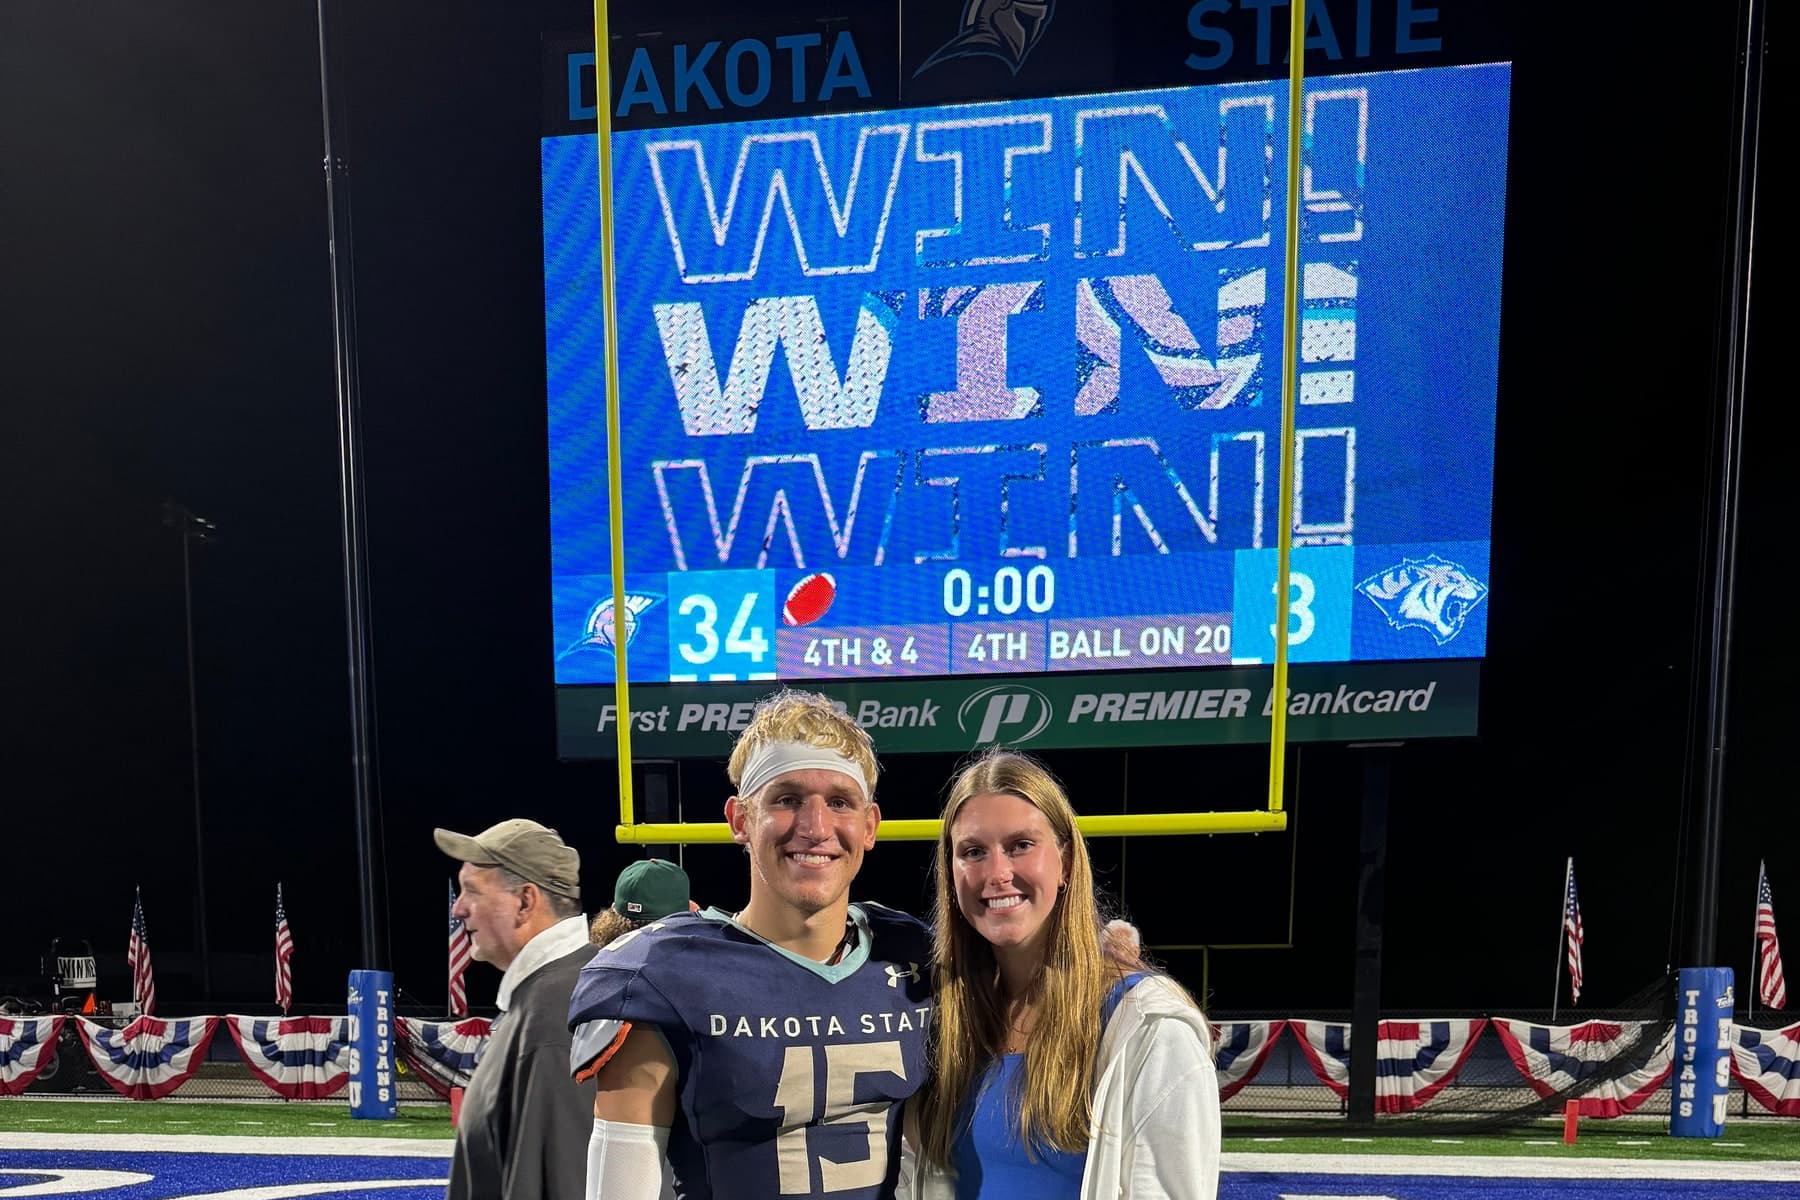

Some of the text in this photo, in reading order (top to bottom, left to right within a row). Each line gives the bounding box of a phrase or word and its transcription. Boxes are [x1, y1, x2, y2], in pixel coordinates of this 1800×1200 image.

[567, 31, 872, 121] DAKOTA
[943, 565, 1055, 616] 0:00
[1270, 571, 1316, 646] 3
[678, 592, 769, 664] 34
[803, 636, 918, 667] 4TH & 4
[967, 631, 1027, 662] 4TH
[1050, 624, 1232, 659] BALL ON 20
[597, 704, 670, 733] Frst
[856, 699, 942, 729] Bank
[1068, 688, 1252, 725] PREMIER
[376, 990, 391, 1102] TROJANS
[710, 1007, 933, 1038] DAKOTA STAT
[1679, 990, 1700, 1117] TROJANS
[773, 1040, 908, 1195] 15
